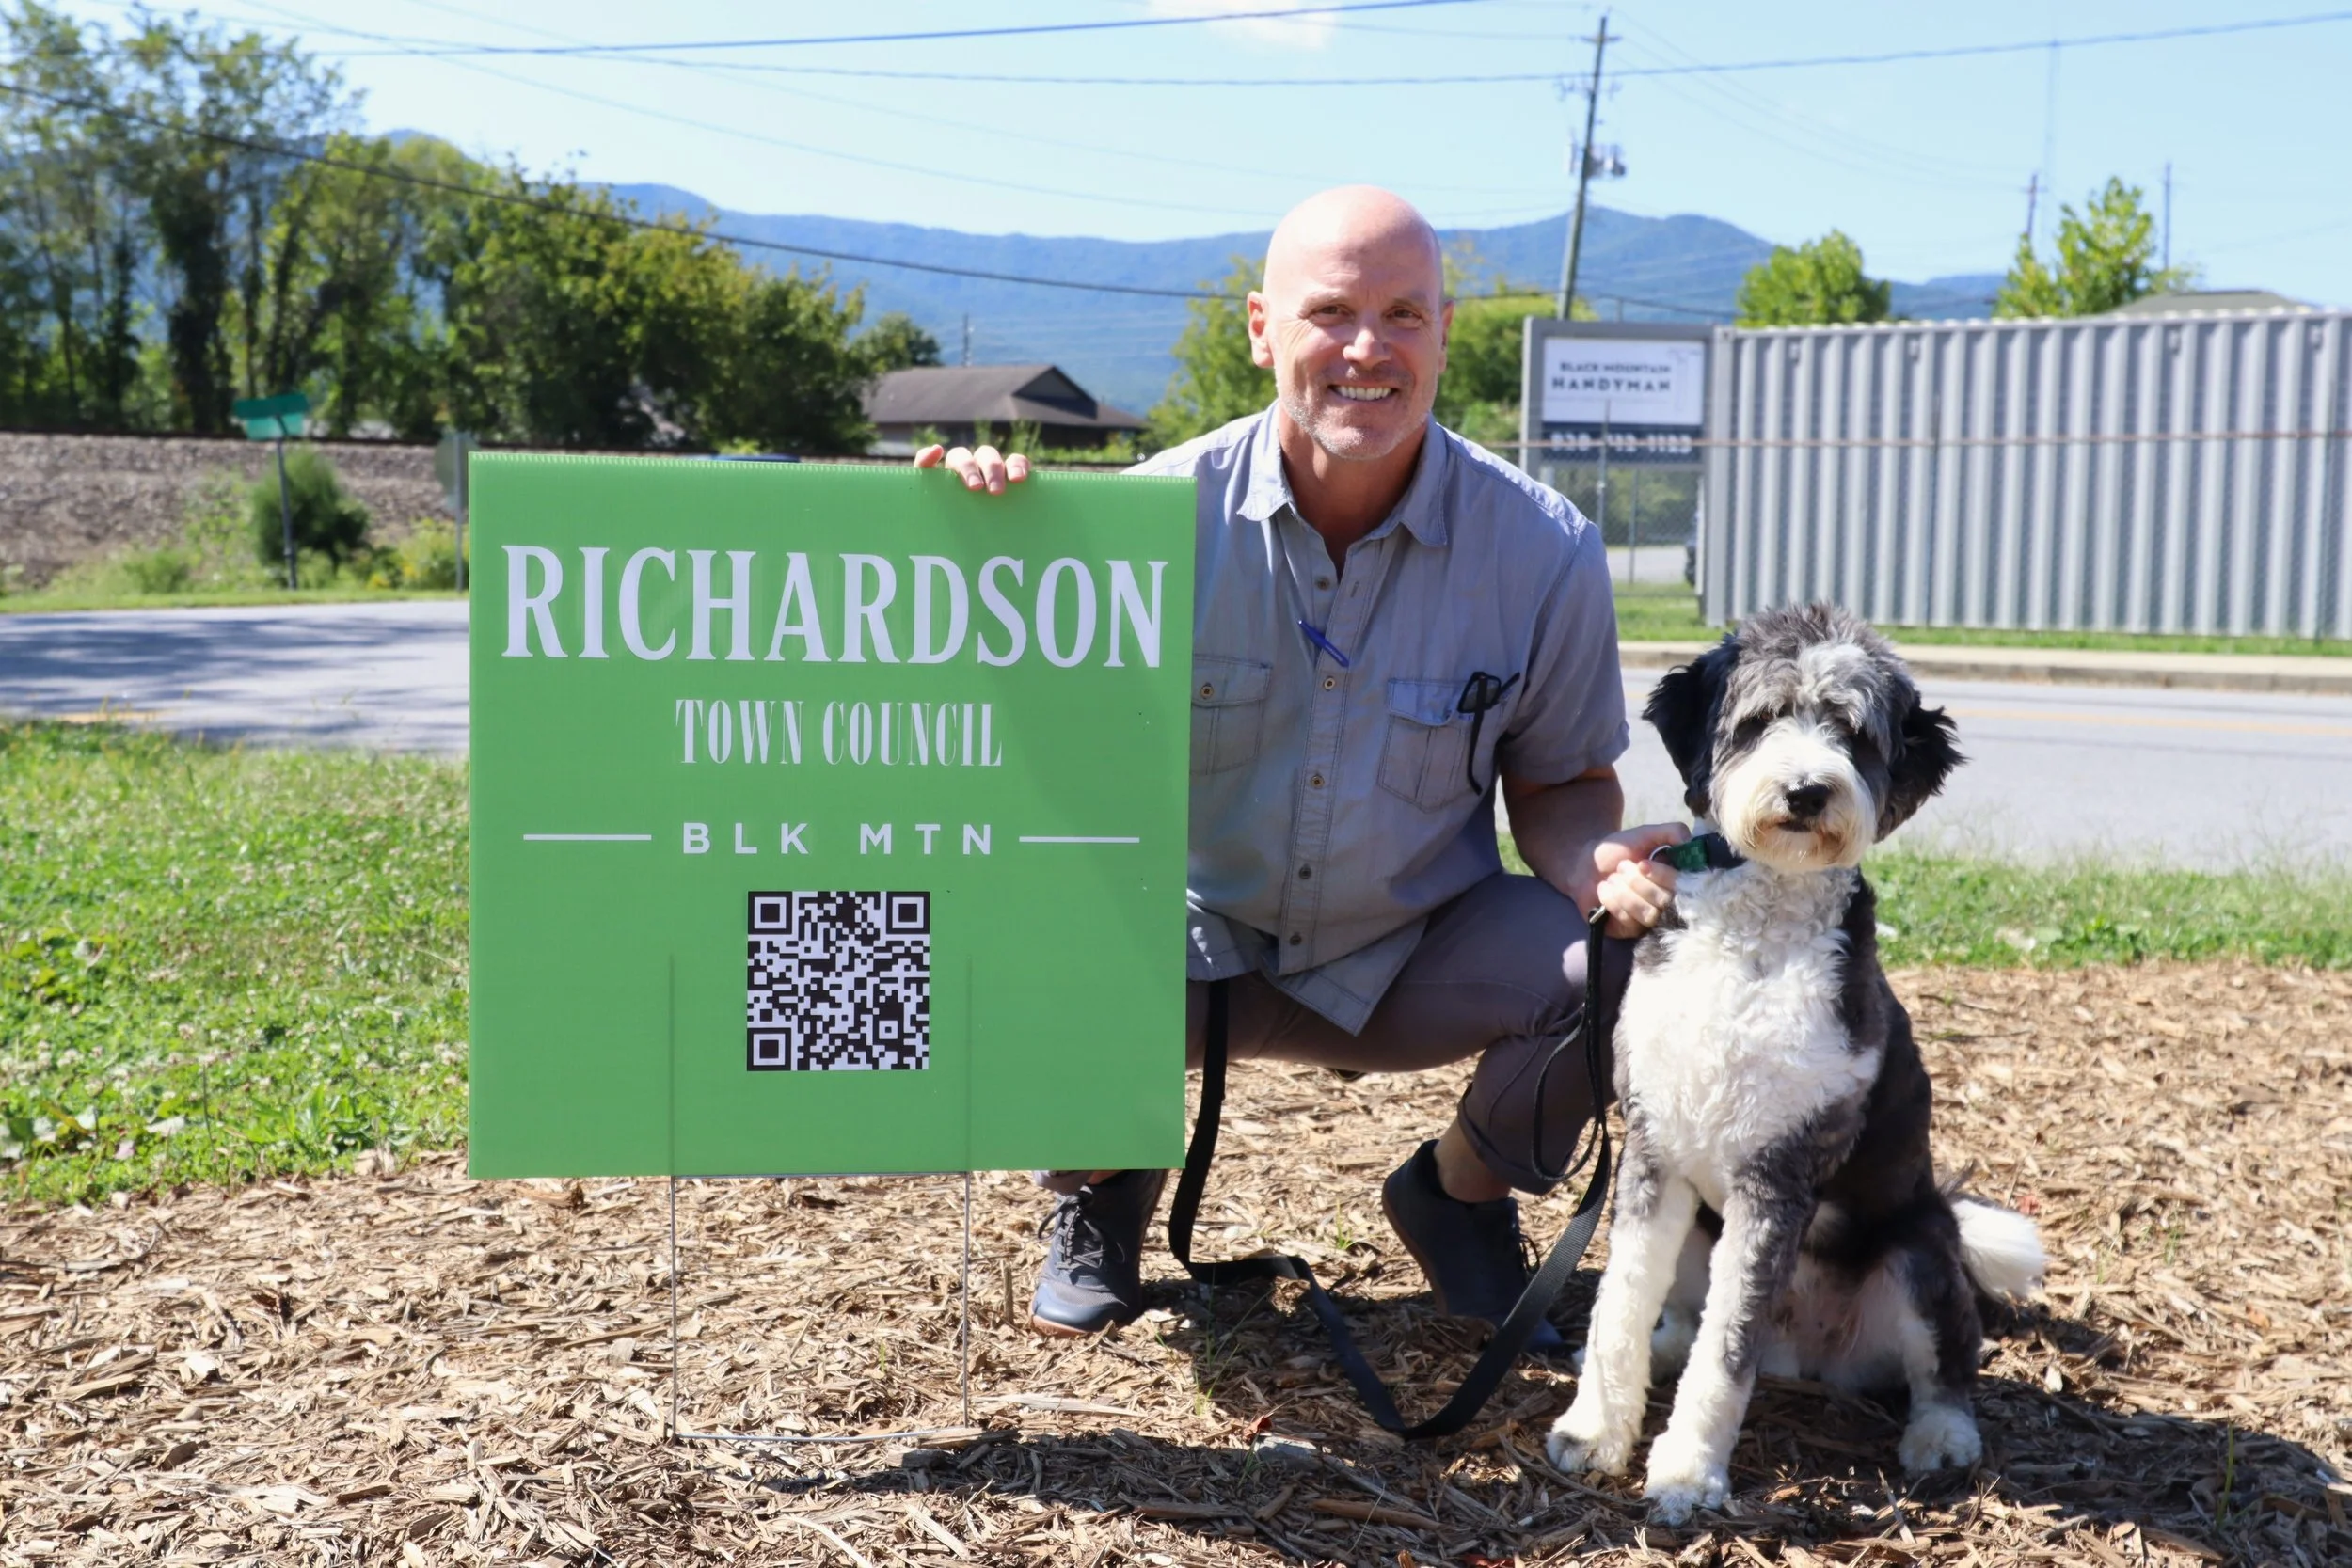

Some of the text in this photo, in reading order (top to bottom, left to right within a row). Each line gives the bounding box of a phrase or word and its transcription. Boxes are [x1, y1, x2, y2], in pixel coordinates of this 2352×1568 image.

[1560, 362, 1672, 373] BLACK MOUNTAIN
[1551, 377, 1671, 392] HANDYMAN
[501, 545, 1168, 668] RICHARDSON
[675, 699, 1001, 767] TOWN COUNCIL
[683, 823, 992, 855] BLK MTN
